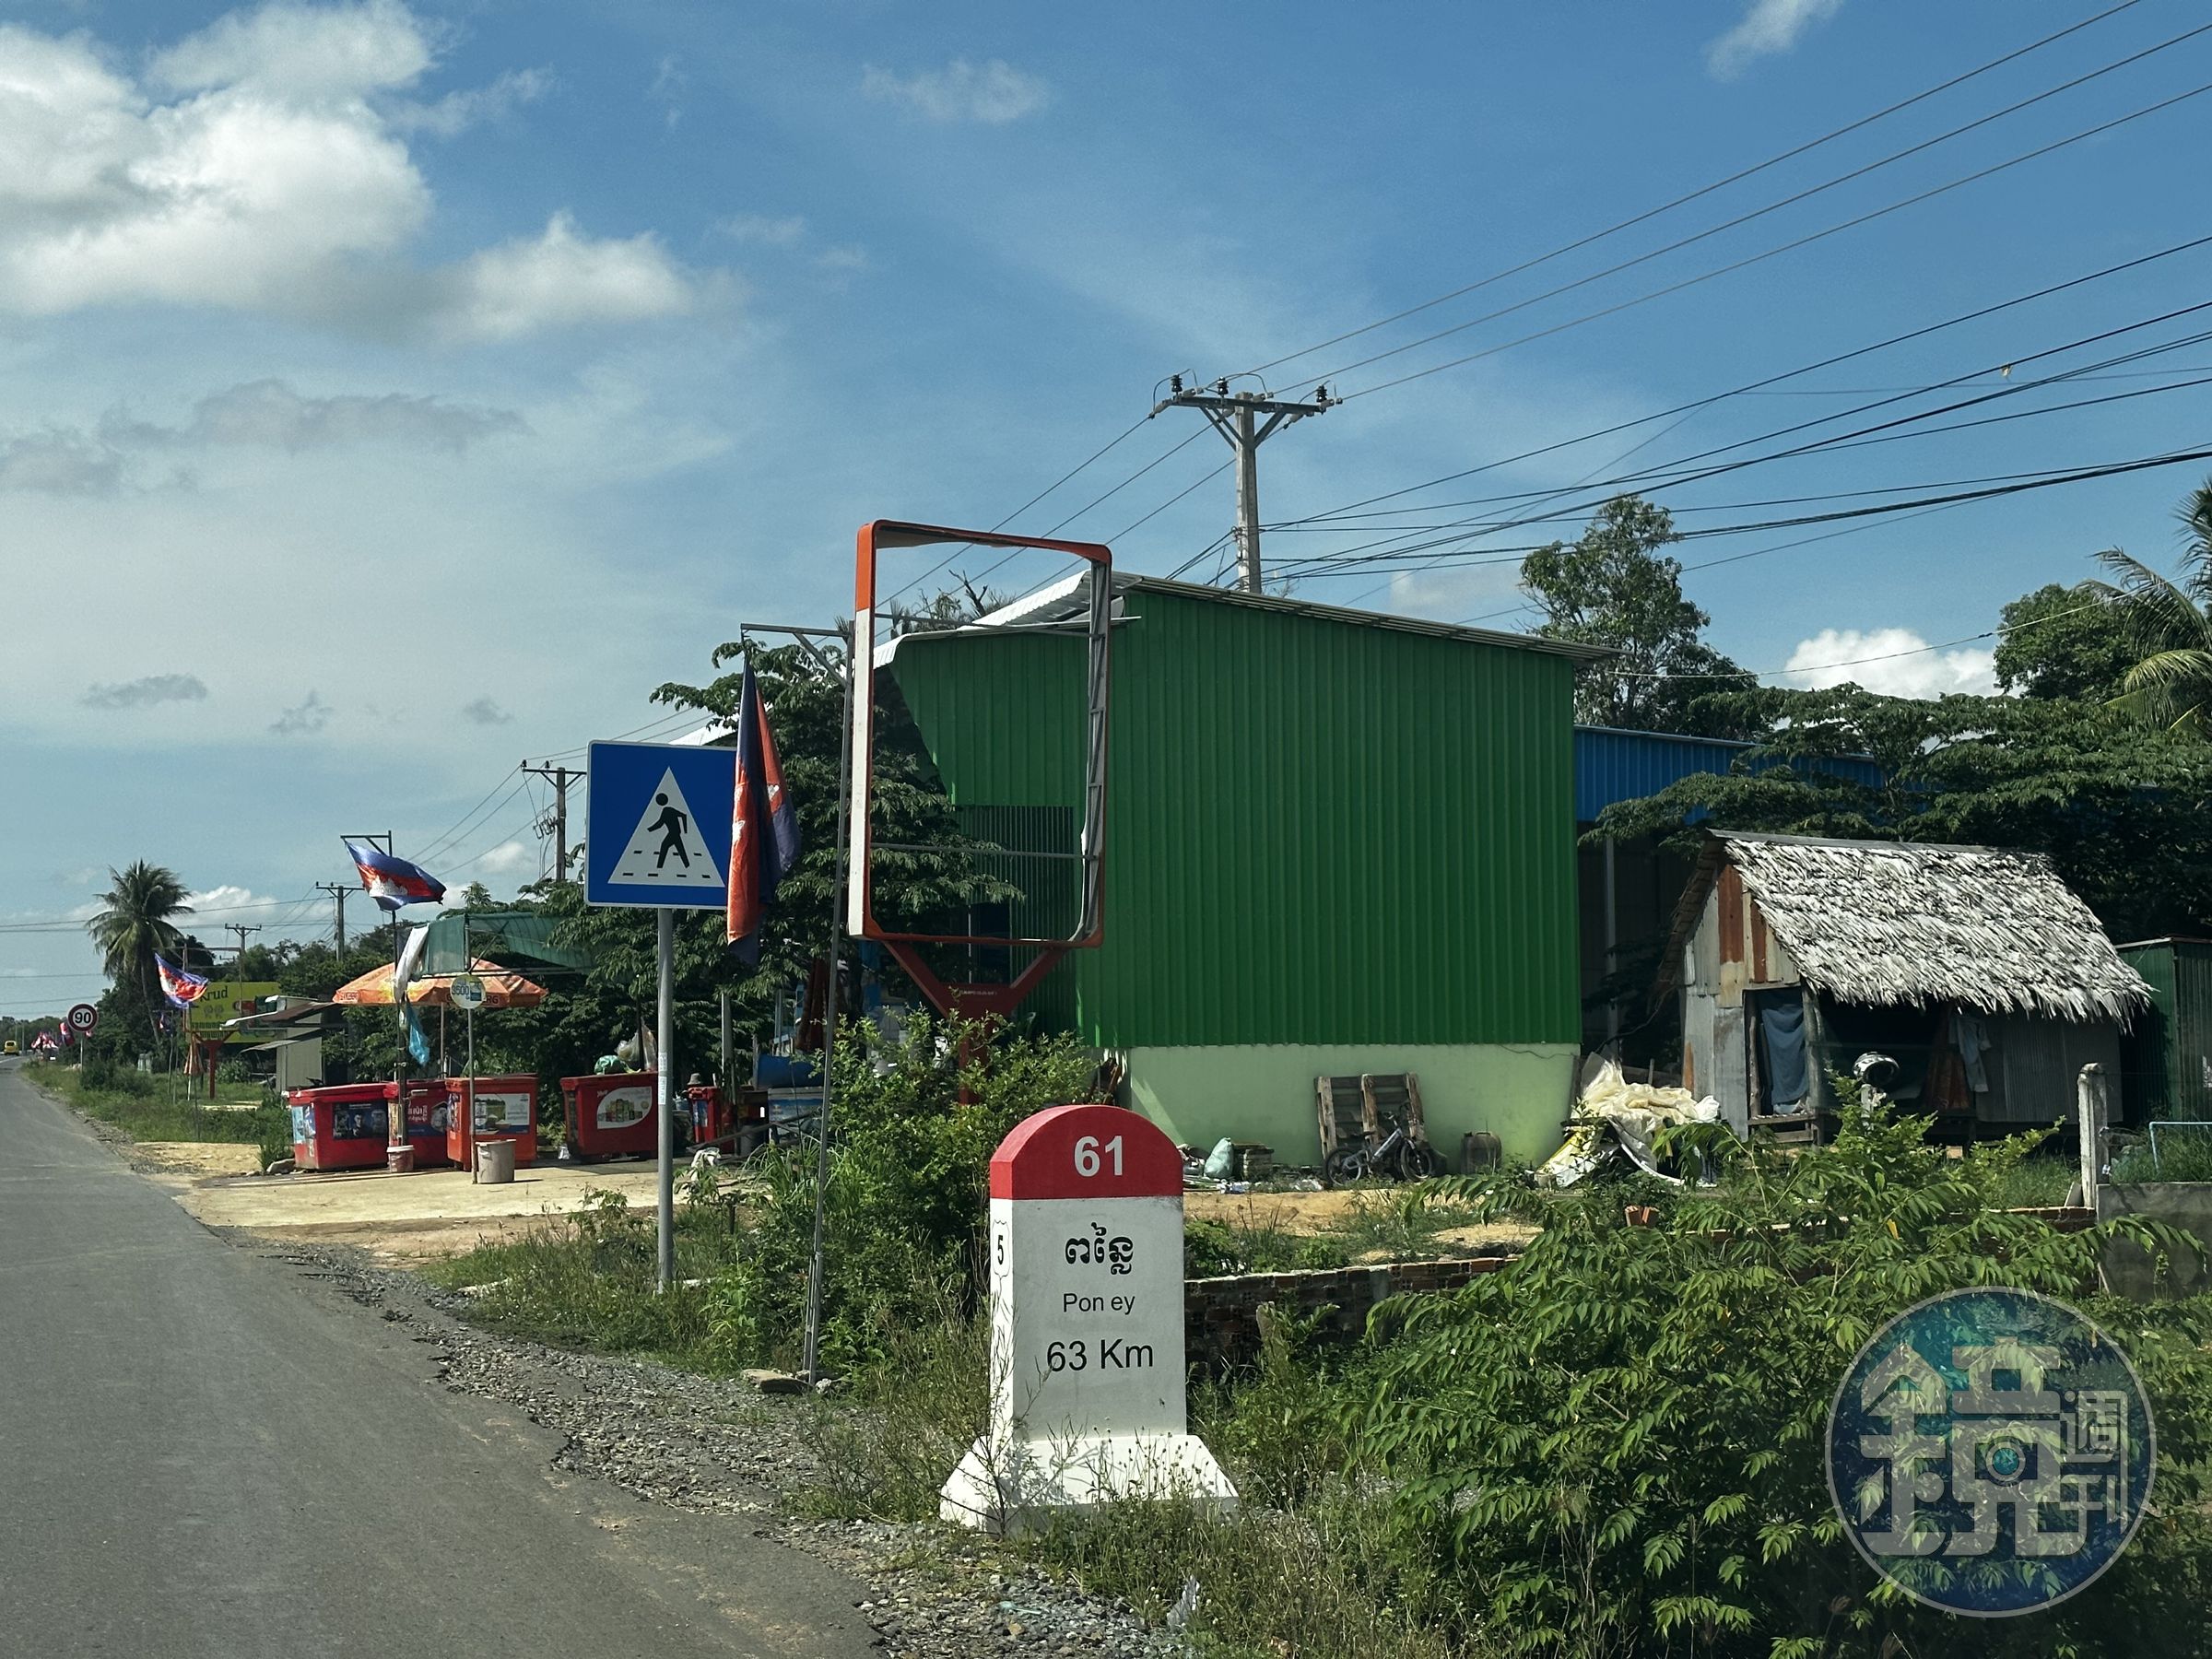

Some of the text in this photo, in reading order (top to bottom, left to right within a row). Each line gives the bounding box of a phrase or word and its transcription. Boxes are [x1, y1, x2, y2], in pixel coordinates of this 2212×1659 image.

[75, 1012, 91, 1024] 90
[1074, 1135, 1123, 1177] 61
[997, 1235, 1004, 1265] 5
[1046, 1338, 1153, 1372] 63 Km
